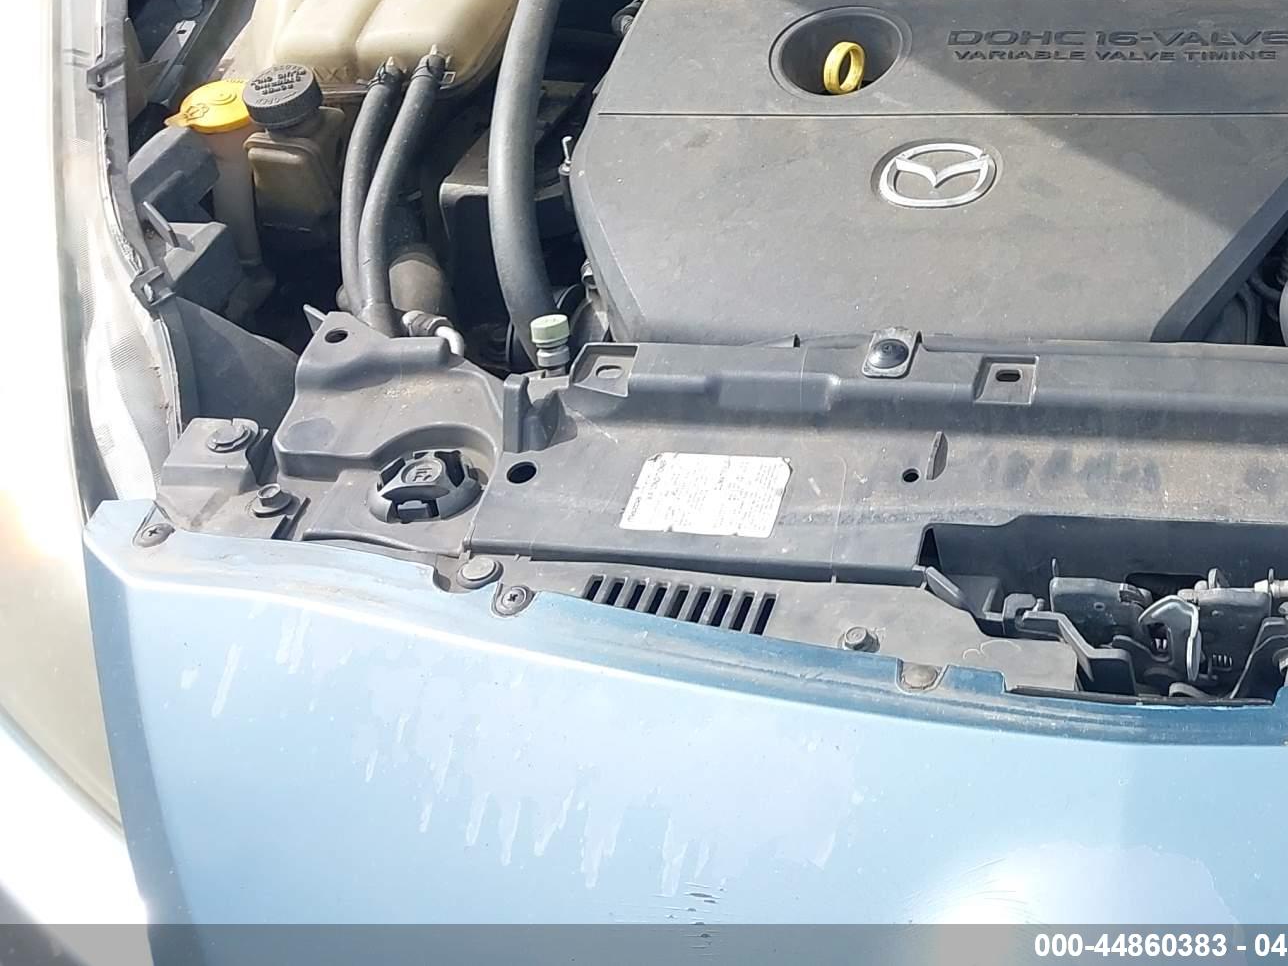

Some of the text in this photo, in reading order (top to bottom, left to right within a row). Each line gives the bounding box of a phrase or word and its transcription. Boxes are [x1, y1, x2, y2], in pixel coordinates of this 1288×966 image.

[948, 30, 1086, 46] DOHC
[953, 50, 1277, 61] VARIABLE VALVE TIMING
